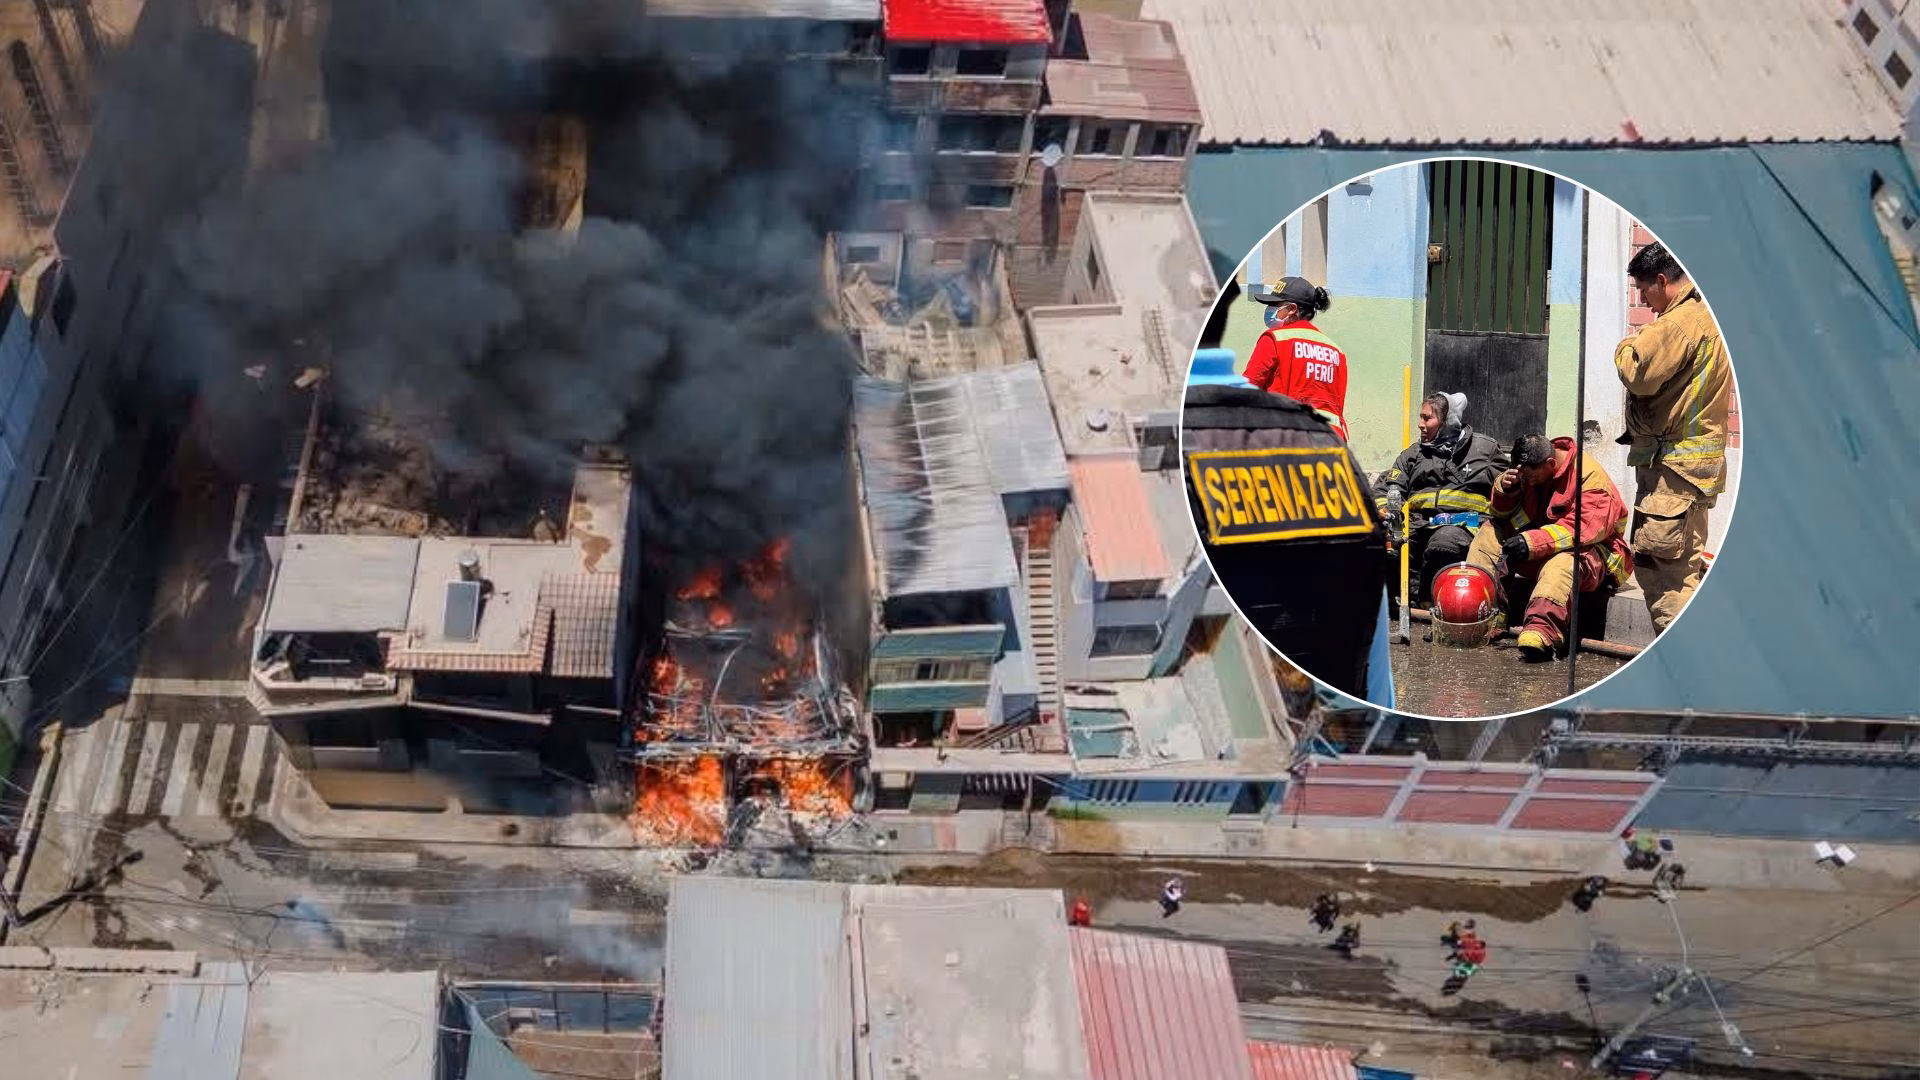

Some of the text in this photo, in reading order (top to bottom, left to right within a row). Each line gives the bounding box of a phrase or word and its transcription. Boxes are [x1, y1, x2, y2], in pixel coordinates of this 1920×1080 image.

[1294, 341, 1340, 367] BOMBERO
[1306, 361, 1334, 384] PERÚ
[1204, 461, 1359, 527] SERENAZGO
